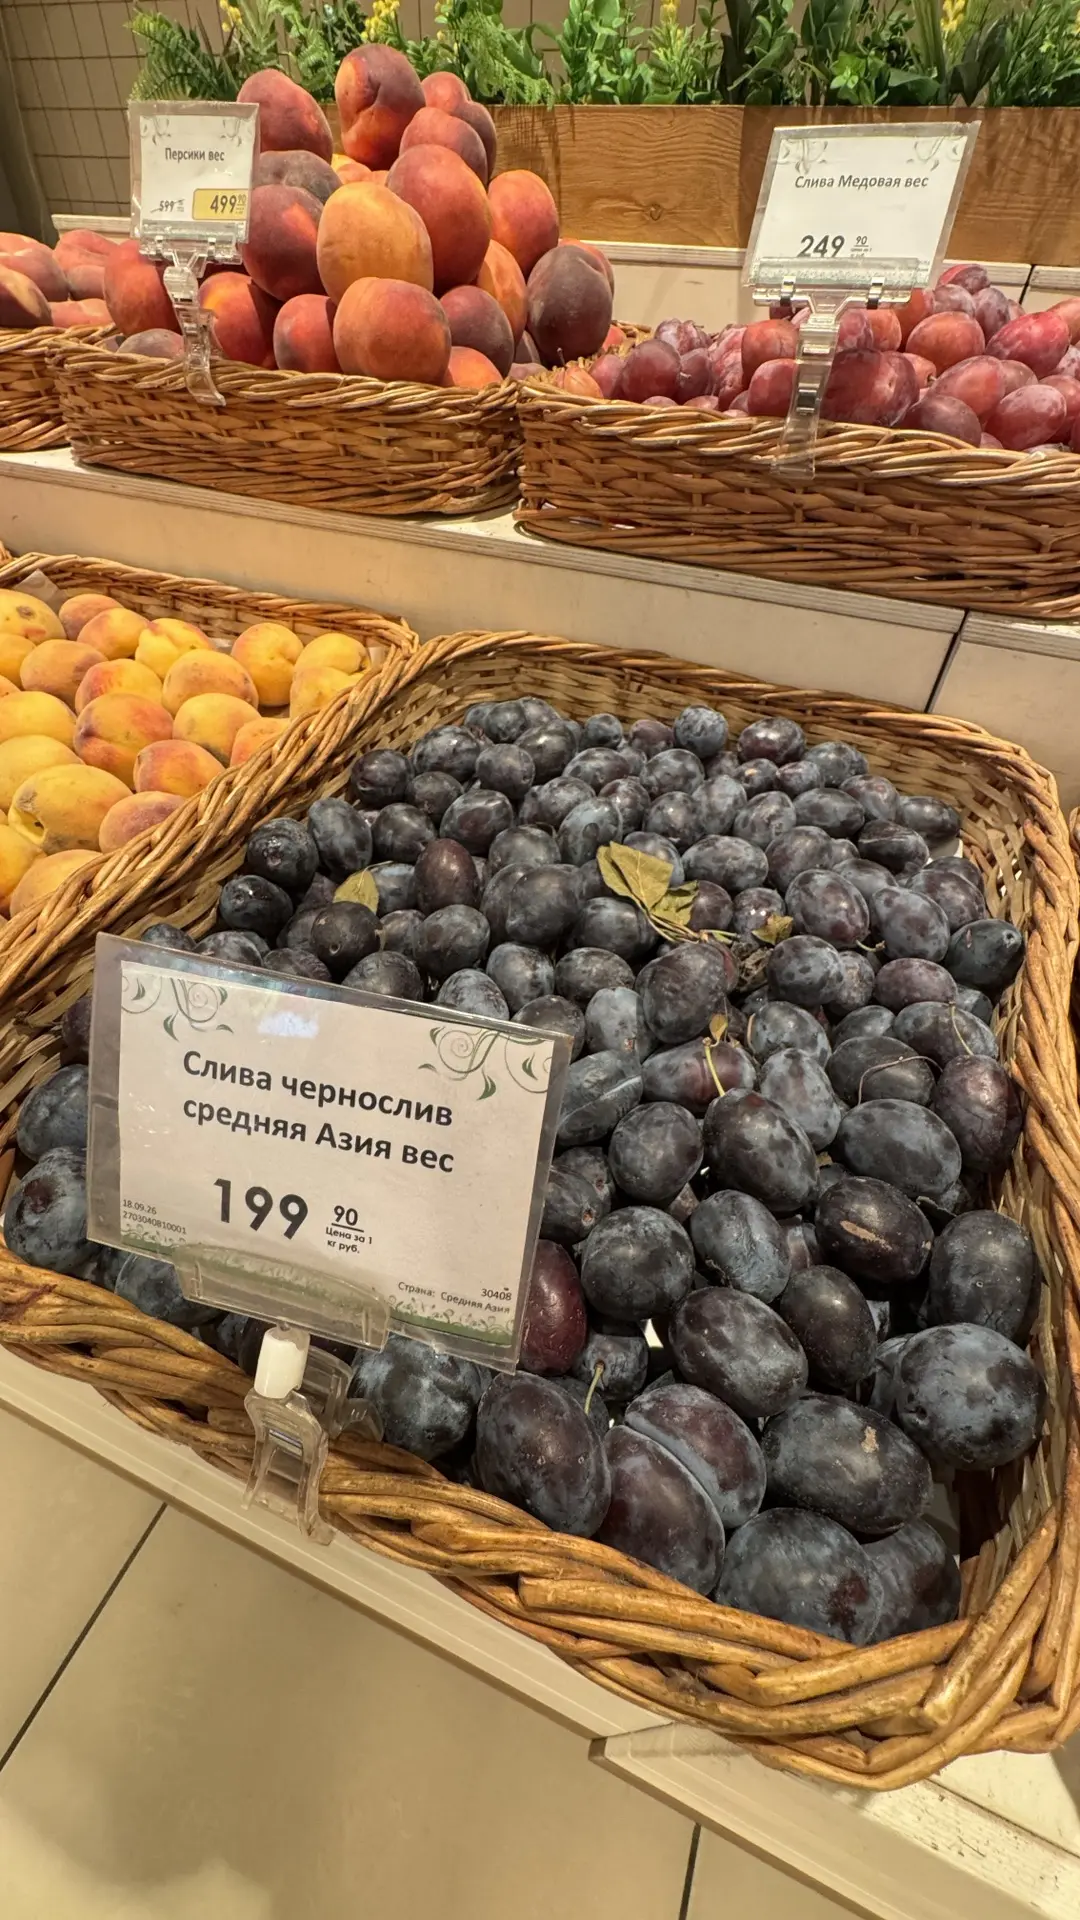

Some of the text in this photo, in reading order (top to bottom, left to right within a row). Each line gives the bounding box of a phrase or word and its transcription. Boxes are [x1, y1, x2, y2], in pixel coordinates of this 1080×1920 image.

[165, 147, 225, 163] Персики вес
[794, 174, 929, 191] Слива Медовая вес
[159, 200, 175, 212] 599
[210, 195, 237, 214] 499
[796, 235, 868, 258] 249 90
[183, 1050, 453, 1127] Слива чернослив
[183, 1099, 455, 1173] средняя Азия вес
[213, 1178, 358, 1240] 199 90
[325, 1226, 352, 1240] Цена
[353, 1235, 366, 1243] за
[327, 1240, 360, 1254] кг руб.
[398, 1281, 510, 1314] Страна: Средняя Азия
[480, 1288, 512, 1301] 30408
